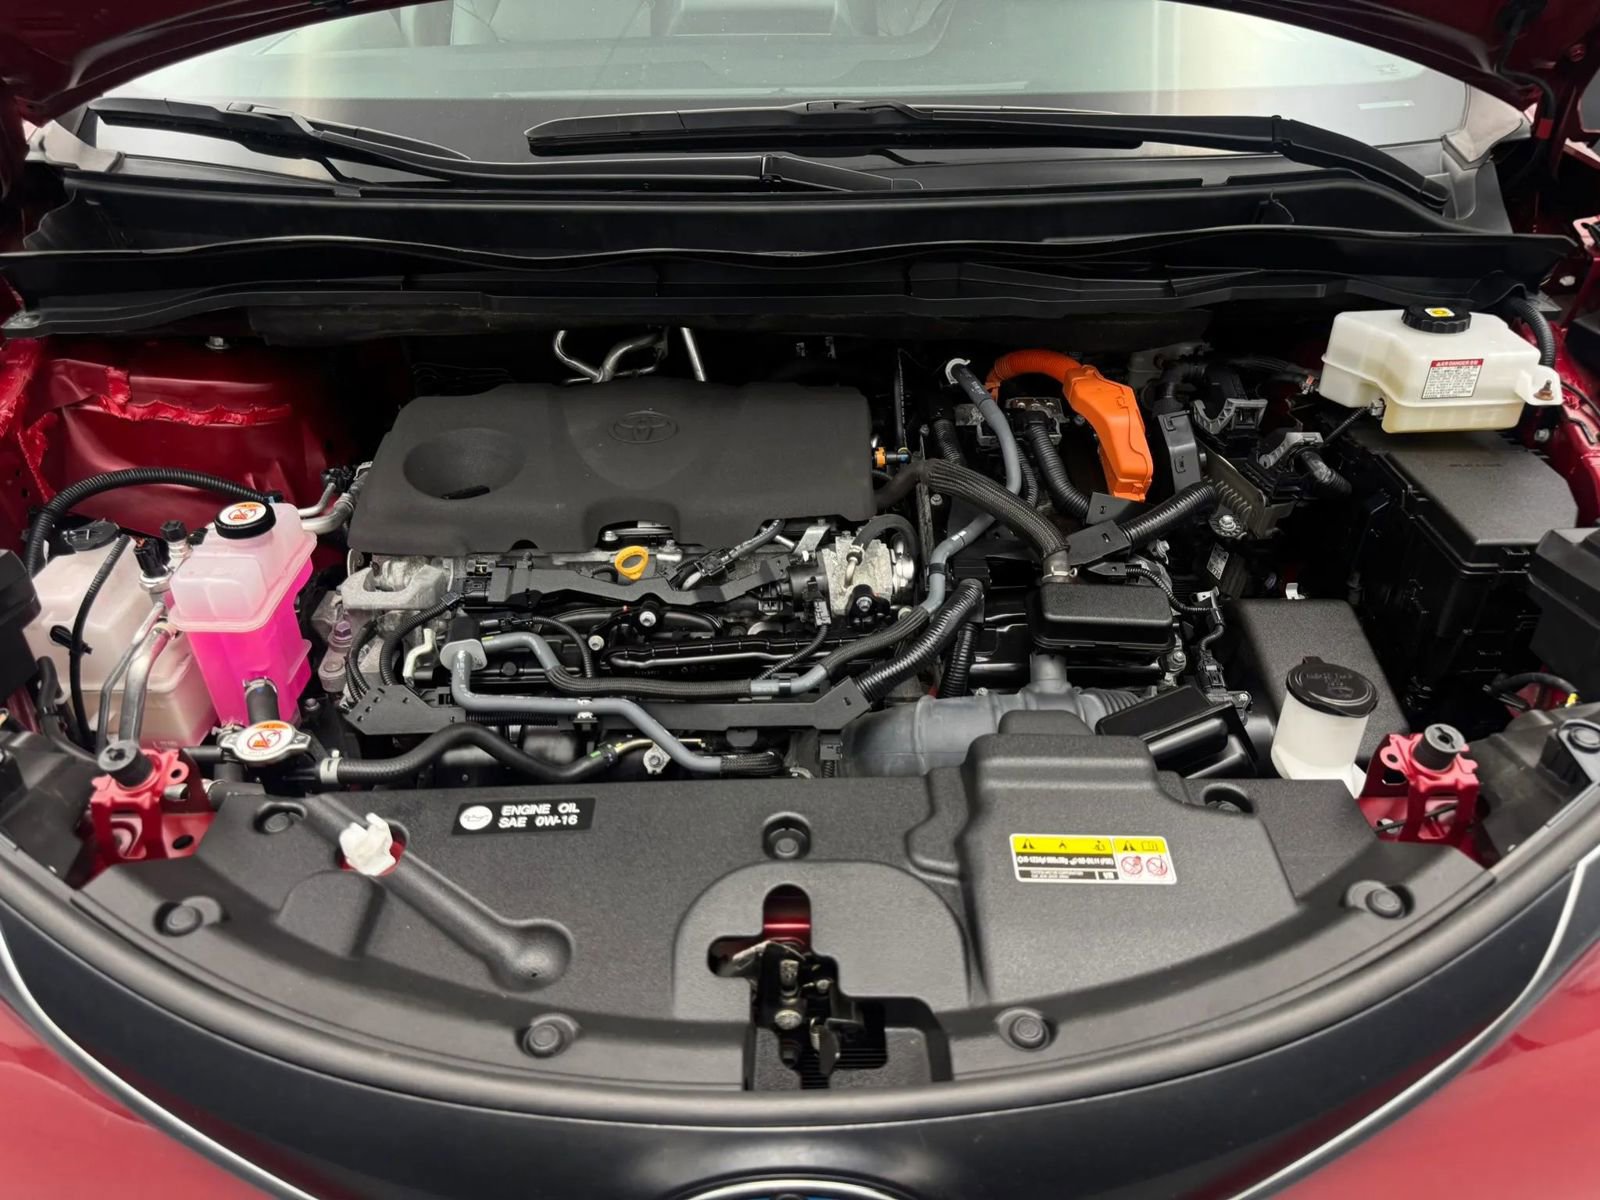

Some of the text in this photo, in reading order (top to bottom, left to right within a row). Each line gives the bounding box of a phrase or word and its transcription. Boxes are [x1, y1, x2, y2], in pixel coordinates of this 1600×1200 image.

[501, 802, 580, 816] ENGINE OIL
[498, 814, 578, 828] SAE 0W-16
